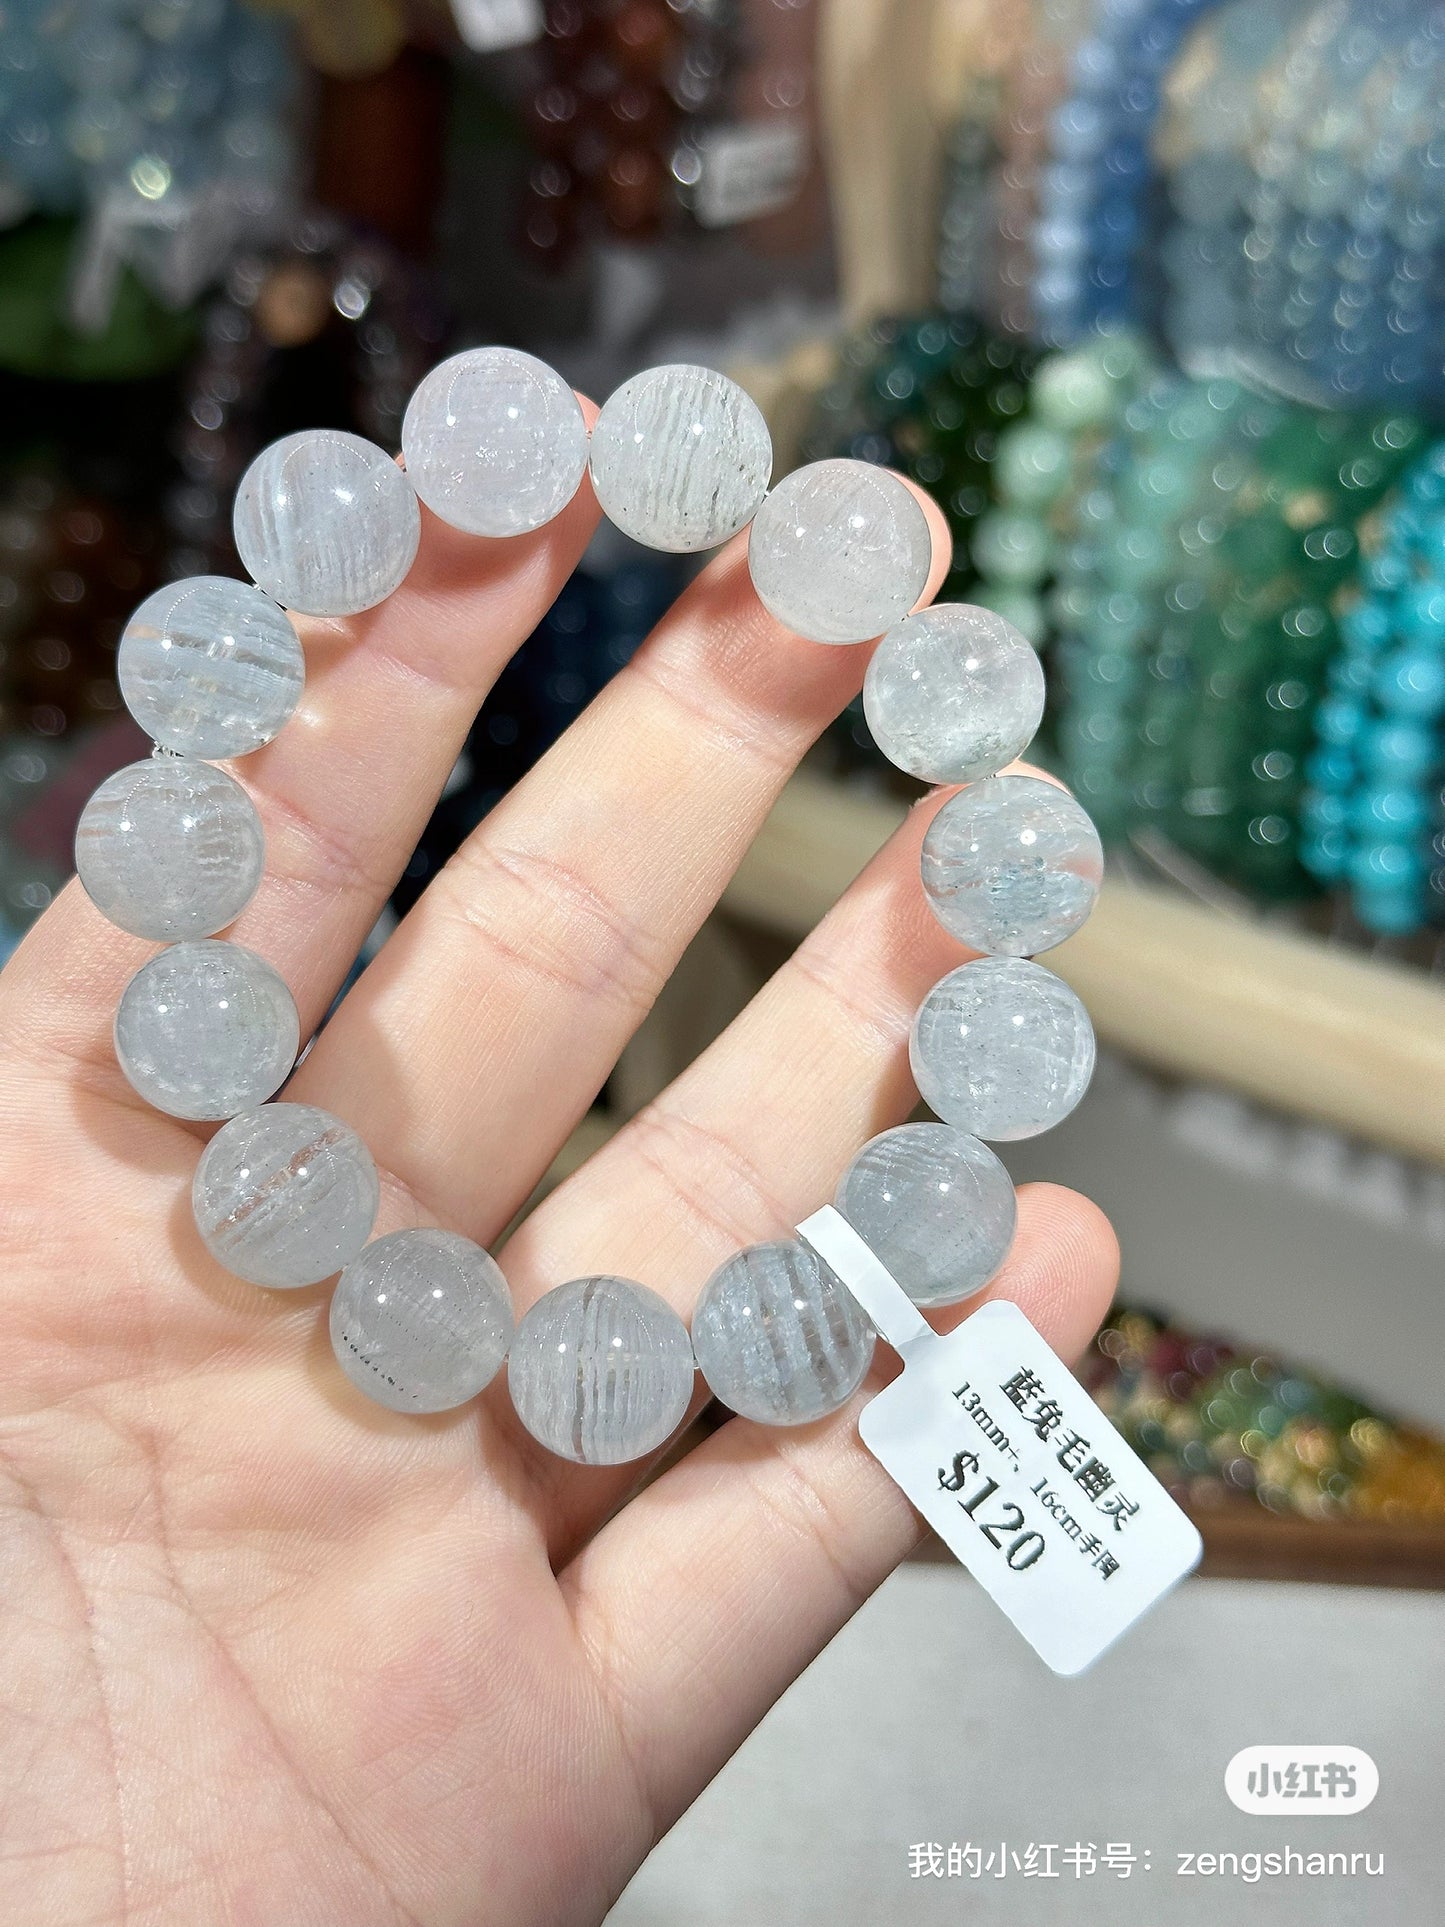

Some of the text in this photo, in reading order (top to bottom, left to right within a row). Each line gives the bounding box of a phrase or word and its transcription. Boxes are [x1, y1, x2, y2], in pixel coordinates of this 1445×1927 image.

[937, 1449, 1046, 1571] $120
[999, 1365, 1140, 1532] 蓝兔毛幽灵
